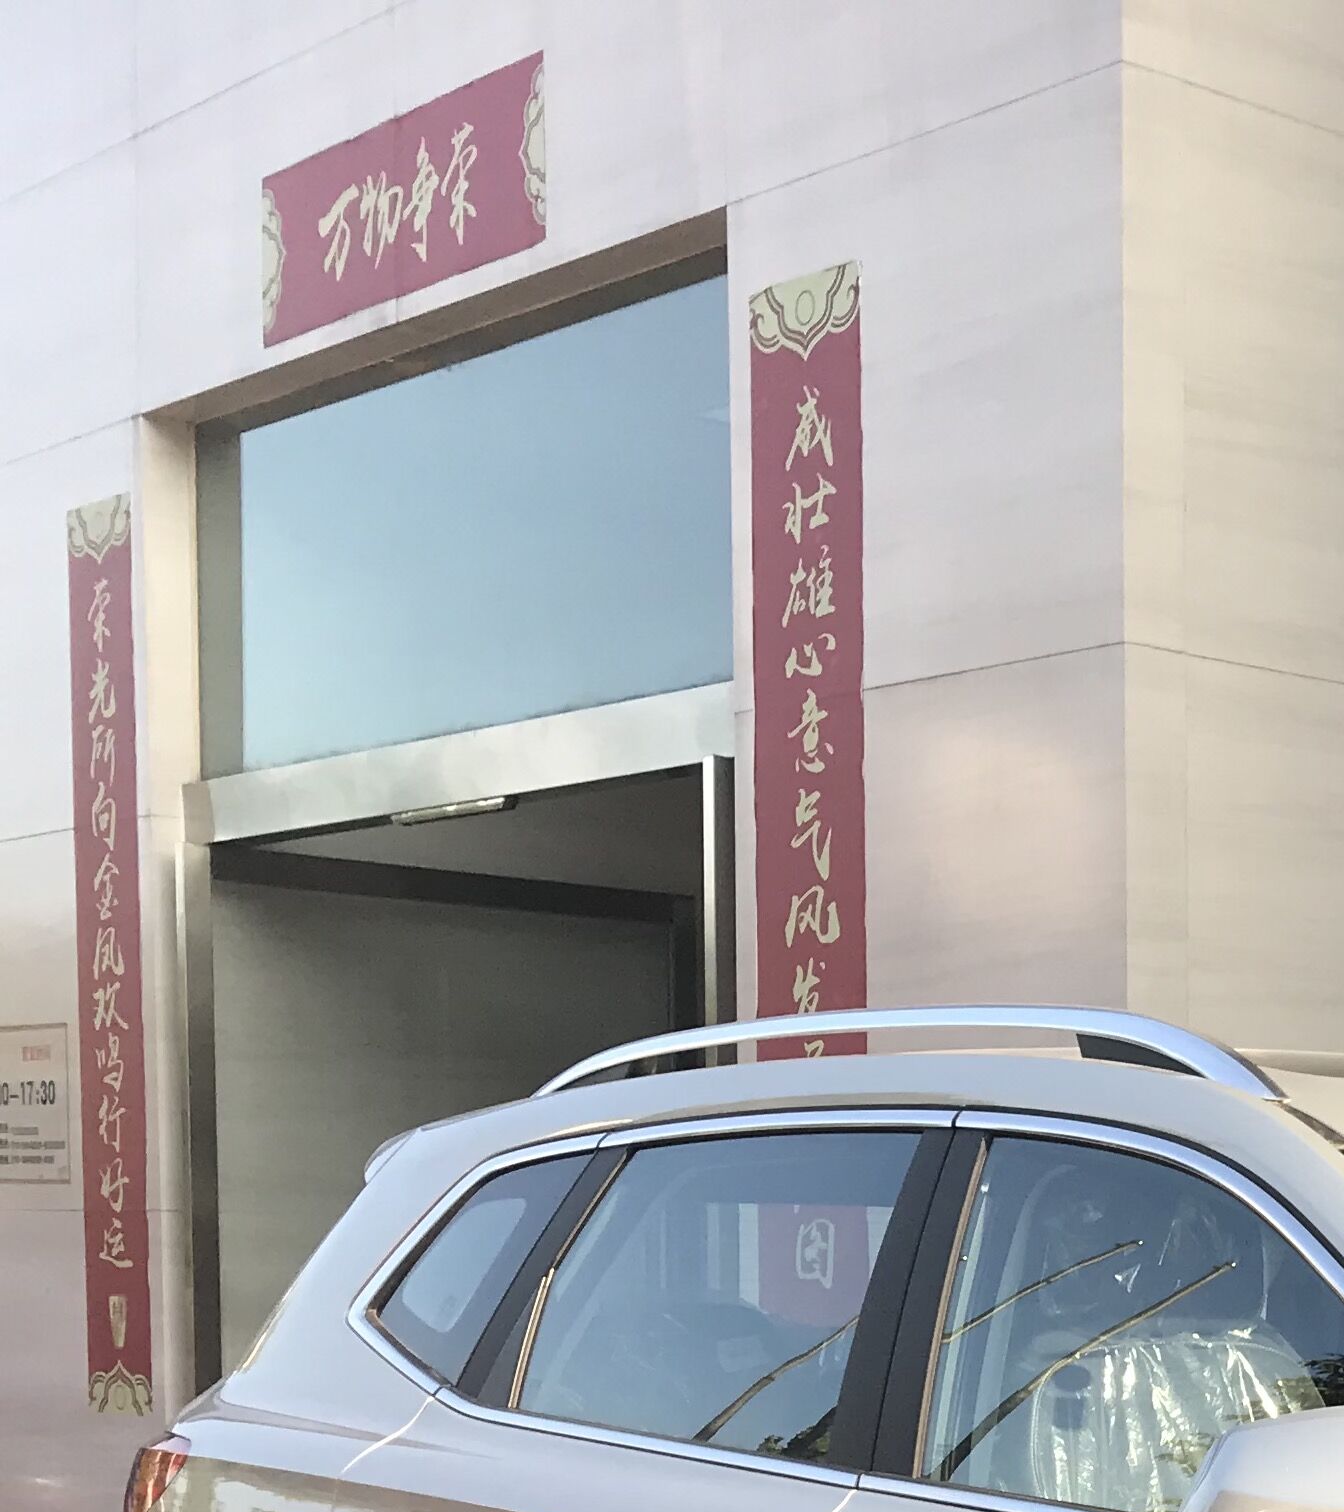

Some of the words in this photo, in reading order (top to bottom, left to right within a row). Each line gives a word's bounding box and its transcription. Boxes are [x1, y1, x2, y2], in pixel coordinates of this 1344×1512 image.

[318, 122, 478, 282] 万物争荣
[0, 1079, 56, 1106] 0-17:30
